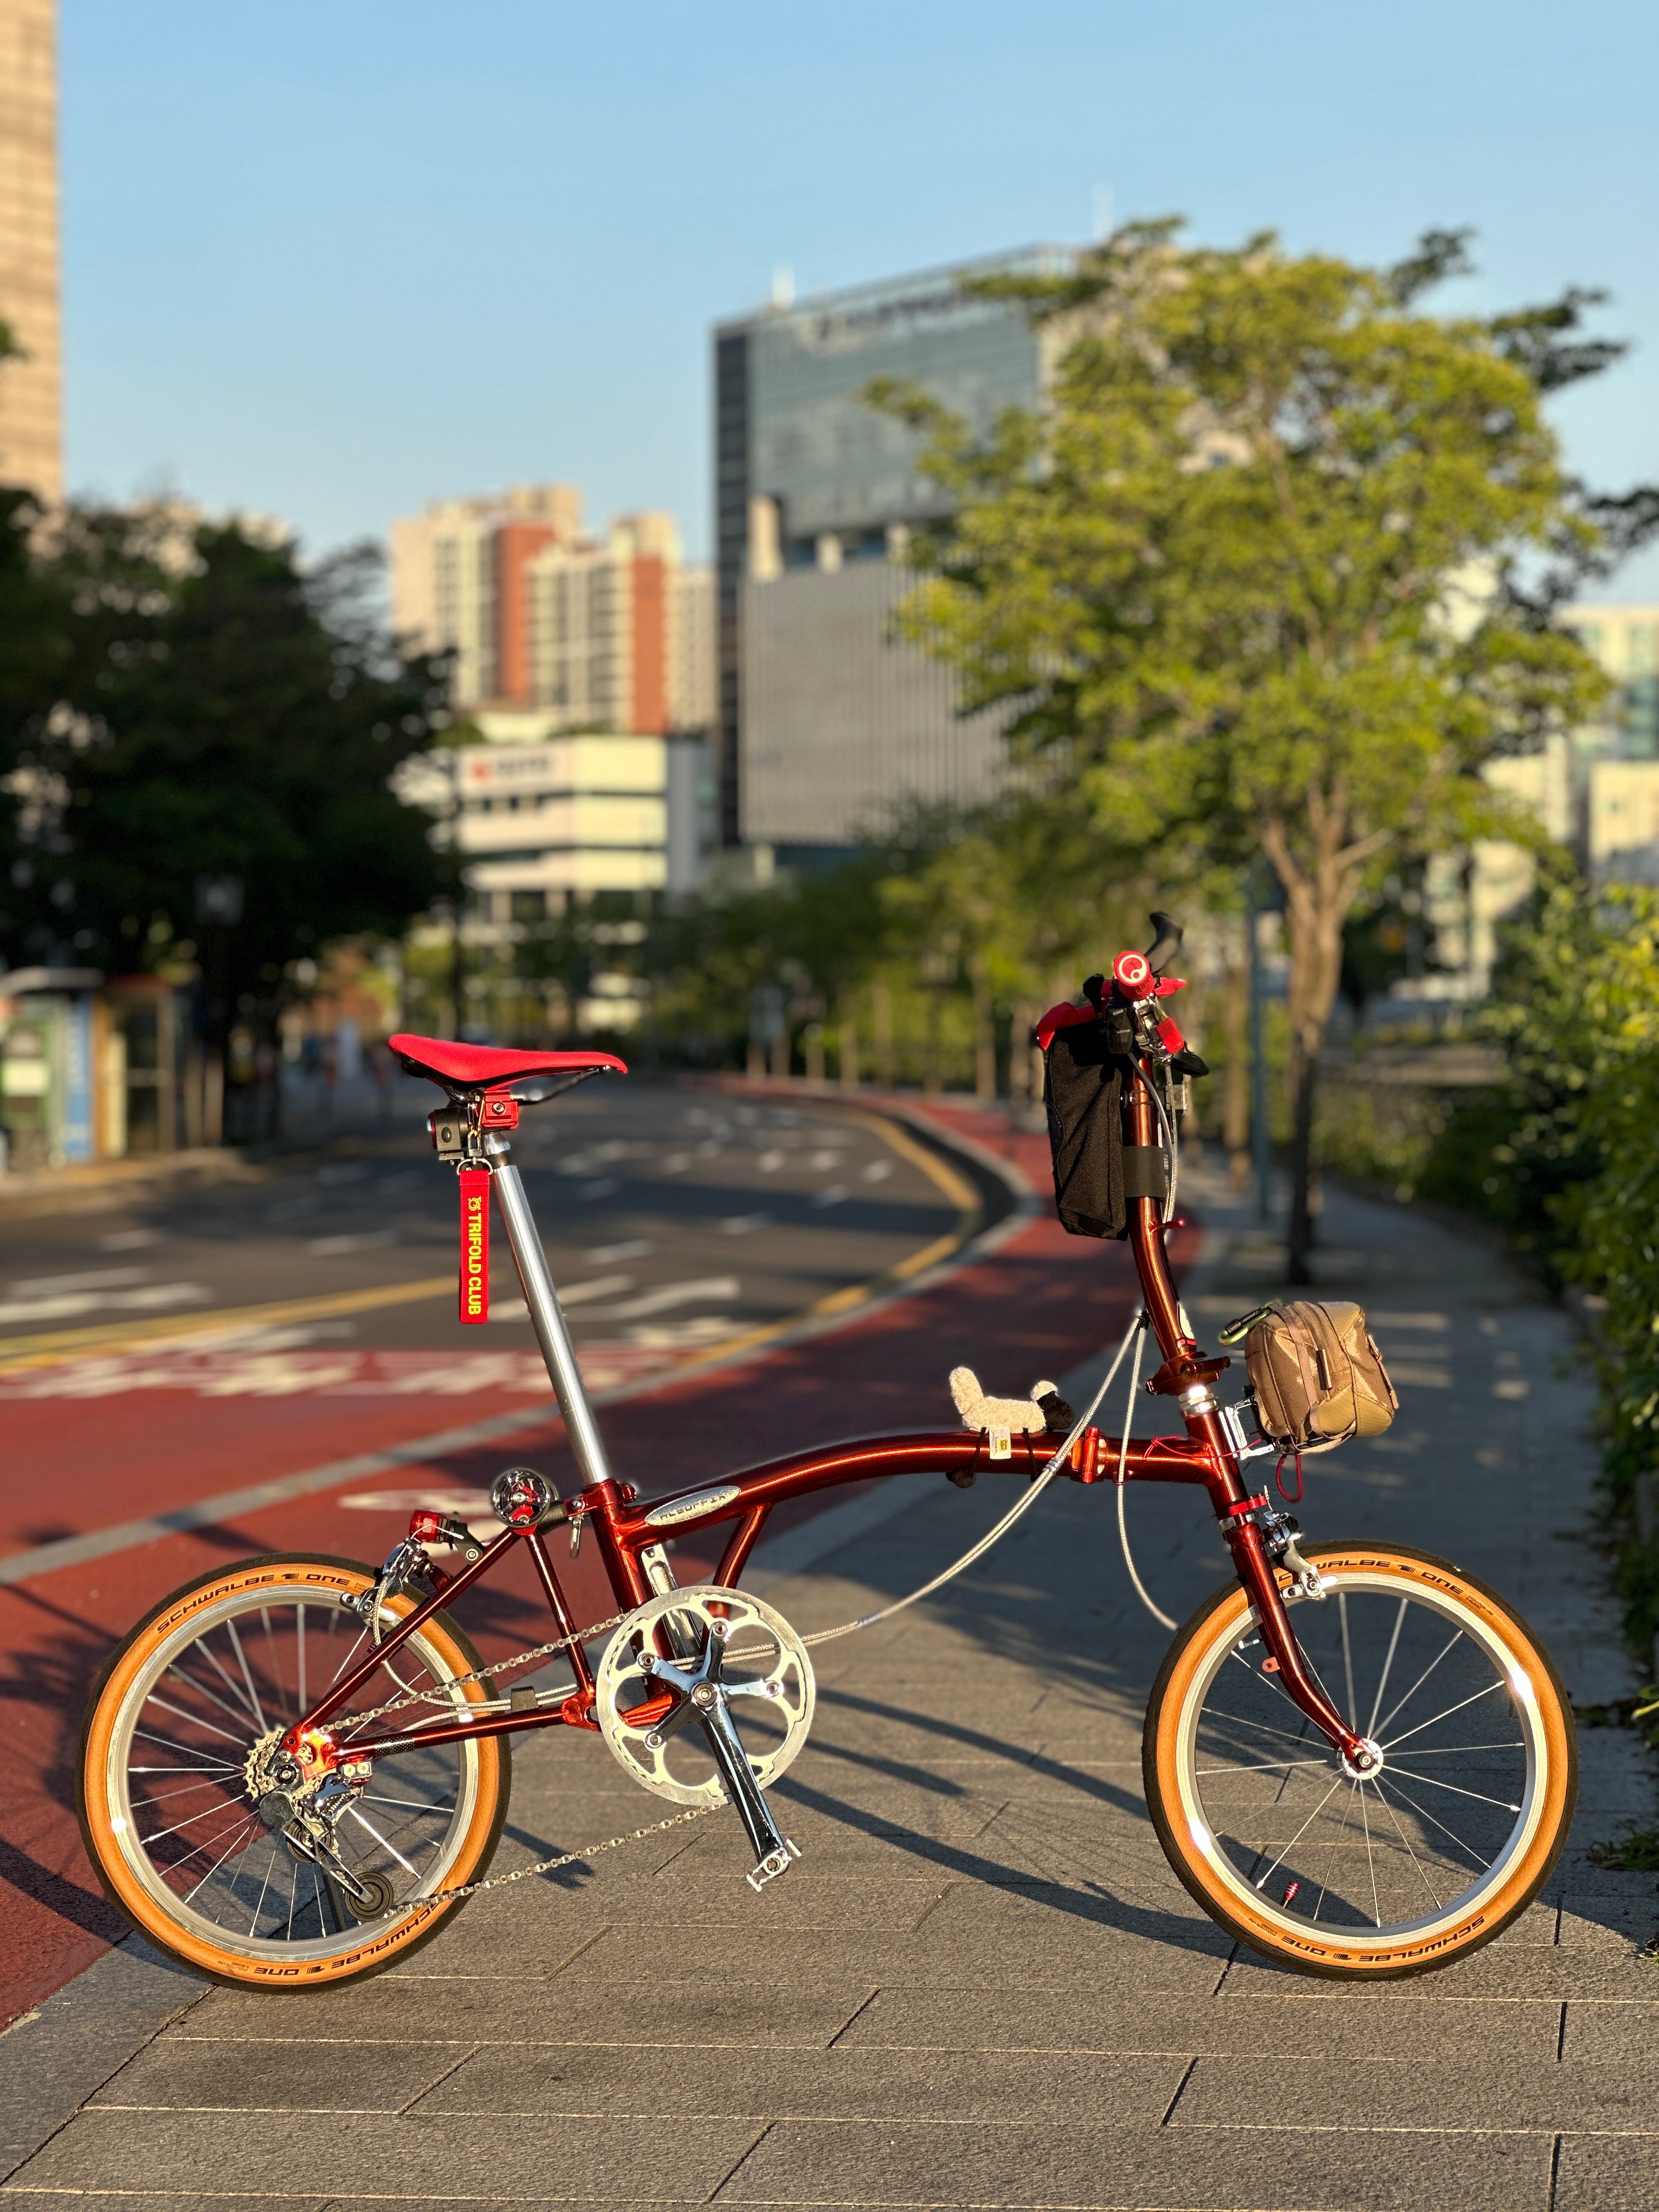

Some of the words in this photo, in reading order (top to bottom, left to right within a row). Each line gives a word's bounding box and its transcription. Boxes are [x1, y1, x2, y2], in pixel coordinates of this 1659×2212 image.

[468, 1212, 482, 1274] TRIFOLD
[468, 1276, 482, 1316] CLUB
[1421, 1571, 1464, 1595] ONE
[157, 1574, 275, 1634] SCHWALBE
[306, 1573, 351, 1586] ONE
[1280, 1936, 1327, 1956] ONE
[1358, 1915, 1485, 1962] SCHWALBE
[253, 1966, 300, 1976] ONE
